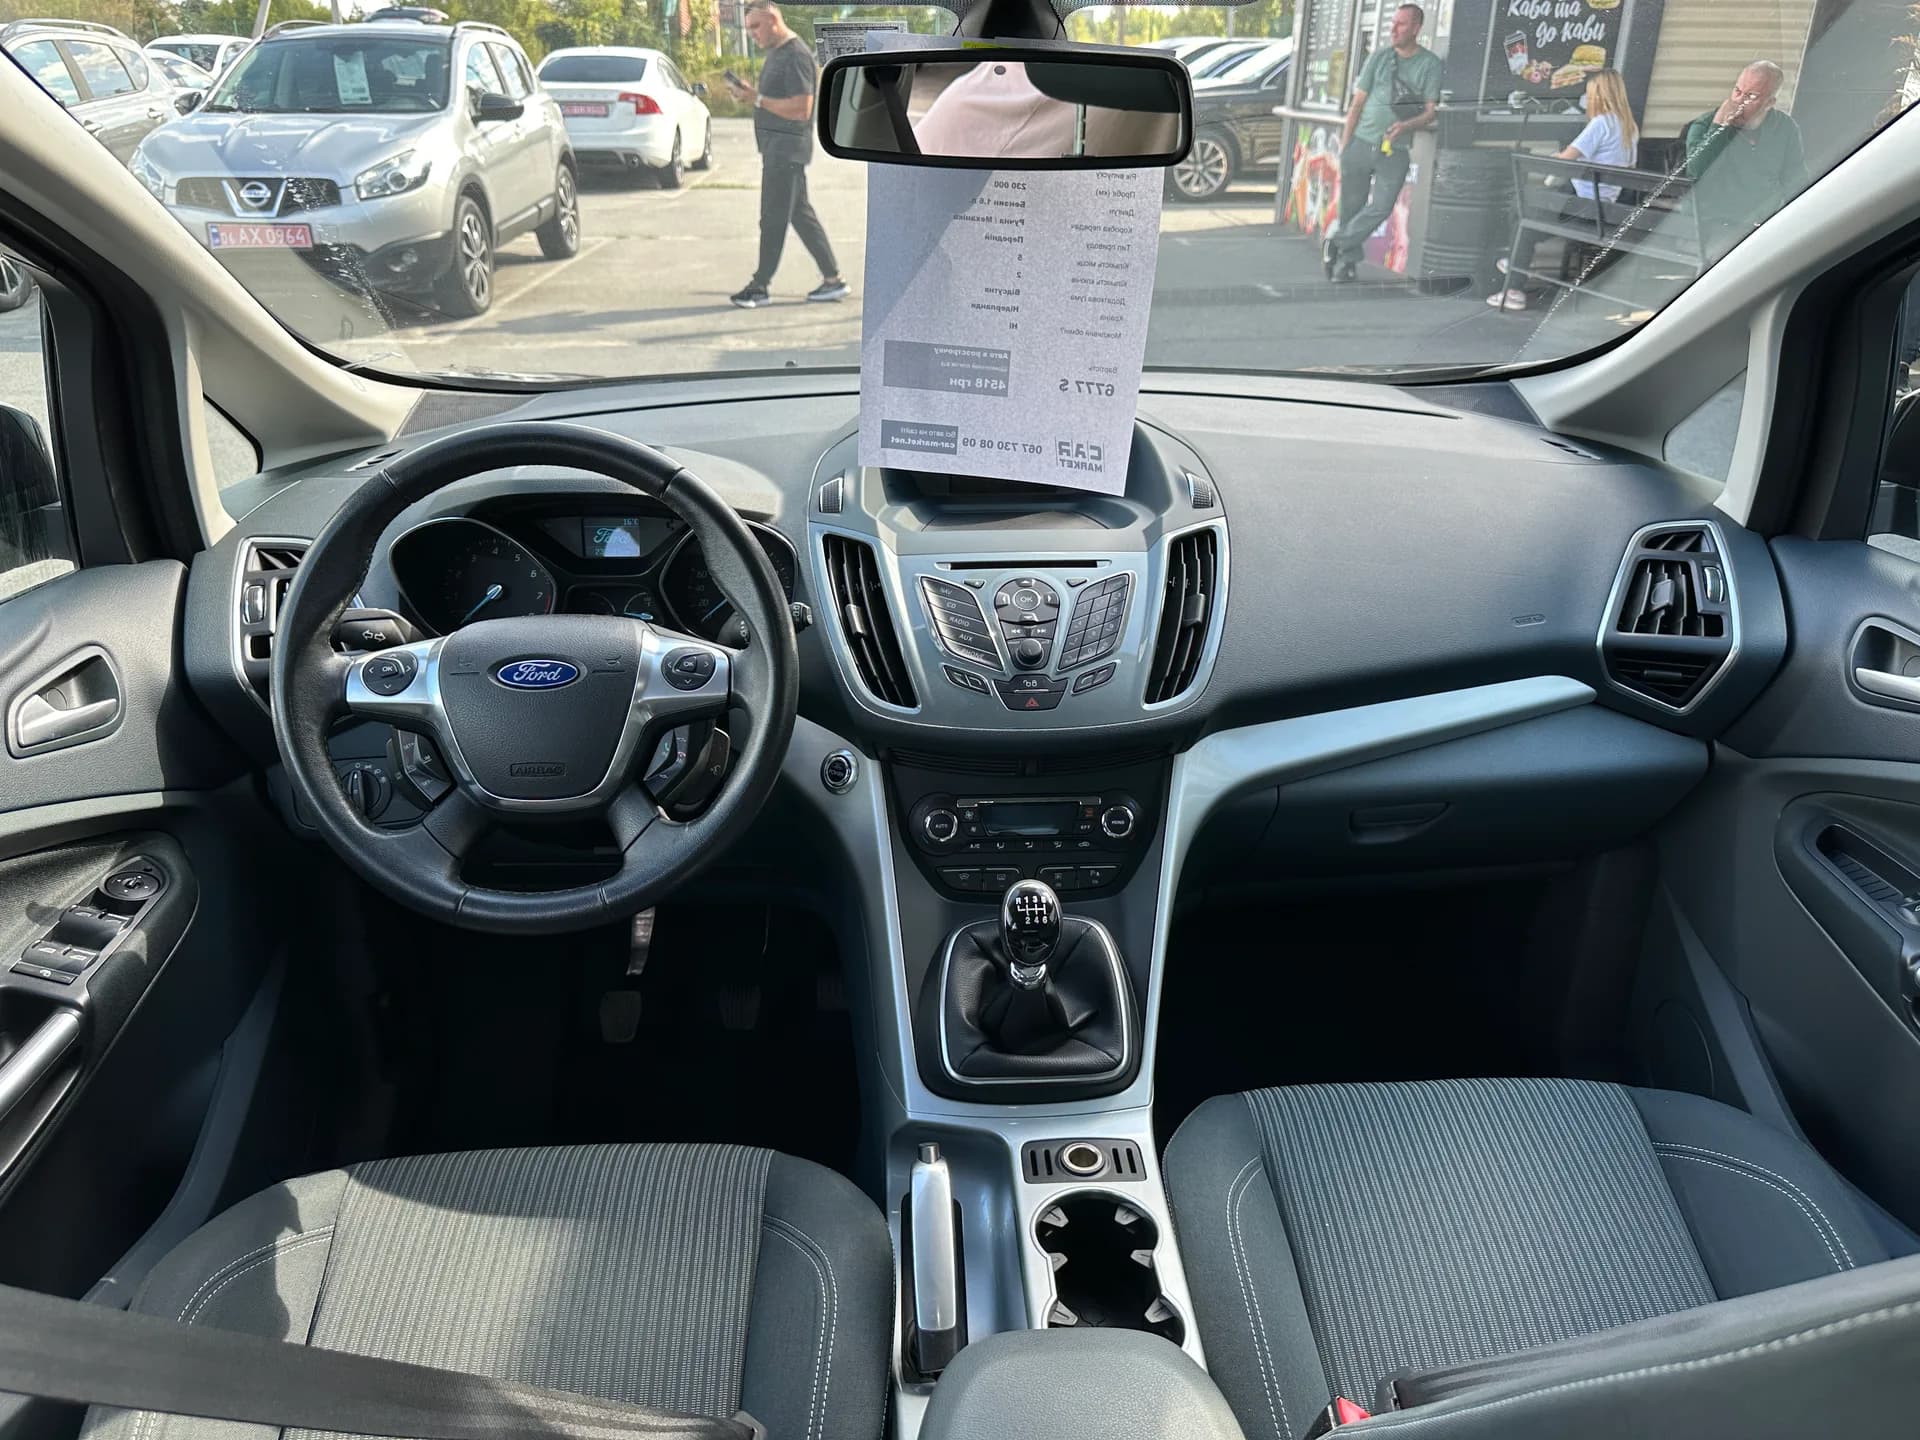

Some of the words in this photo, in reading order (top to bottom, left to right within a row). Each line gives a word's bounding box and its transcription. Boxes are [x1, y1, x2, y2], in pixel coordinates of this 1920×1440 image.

[1536, 22, 1557, 48] до
[1561, 14, 1605, 43] кави
[265, 227, 306, 244] 0964
[529, 569, 538, 579] 6
[946, 601, 957, 609] CD
[948, 615, 970, 627] RADIO
[958, 632, 974, 643] AUX
[381, 664, 394, 672] OK
[683, 660, 695, 668] OK
[513, 662, 563, 681] Ford
[514, 765, 567, 776] AIRBAG
